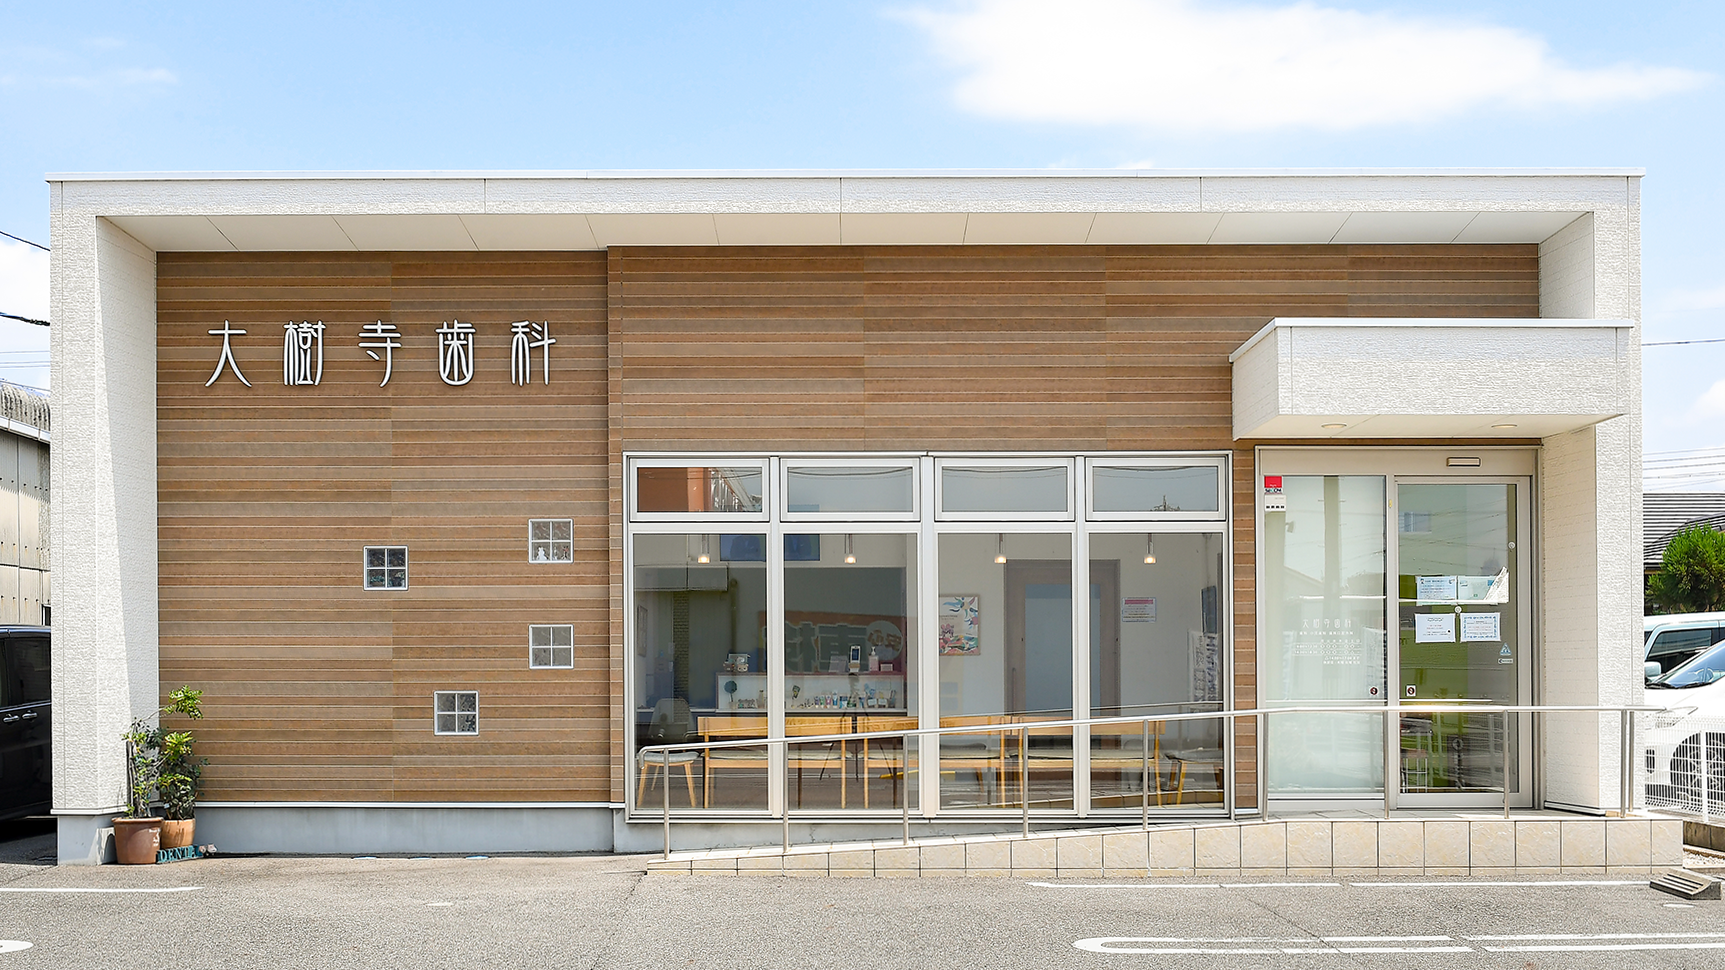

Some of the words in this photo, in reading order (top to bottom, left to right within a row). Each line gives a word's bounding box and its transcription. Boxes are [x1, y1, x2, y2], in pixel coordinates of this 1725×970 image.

[204, 318, 557, 388] 大樹寺歯科
